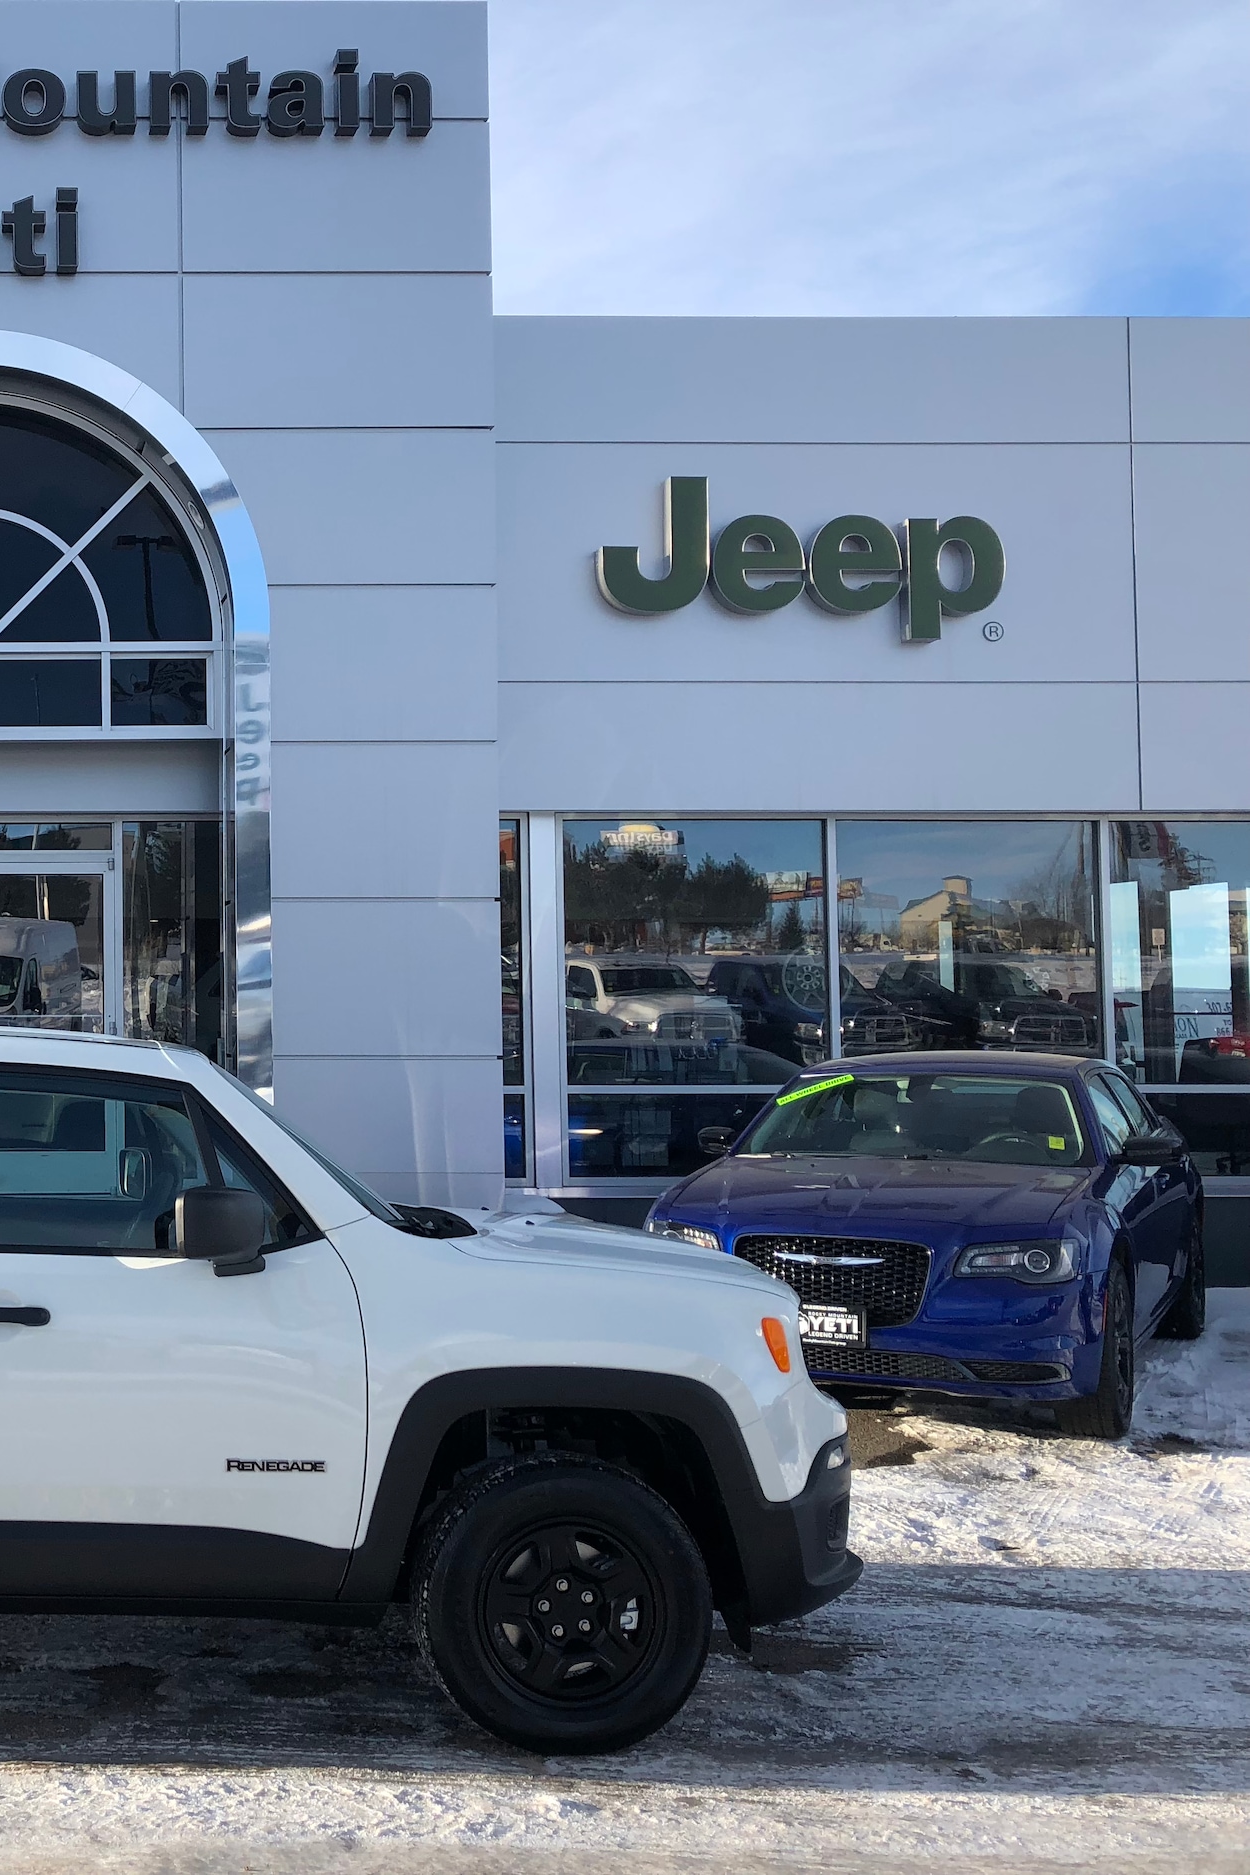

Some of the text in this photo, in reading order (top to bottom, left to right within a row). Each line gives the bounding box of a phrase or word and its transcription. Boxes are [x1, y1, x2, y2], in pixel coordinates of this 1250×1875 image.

[595, 476, 1006, 645] Jeep
[796, 1084, 822, 1096] WHEEL
[809, 1315, 859, 1334] YETI
[226, 1458, 326, 1472] RENEGADE
